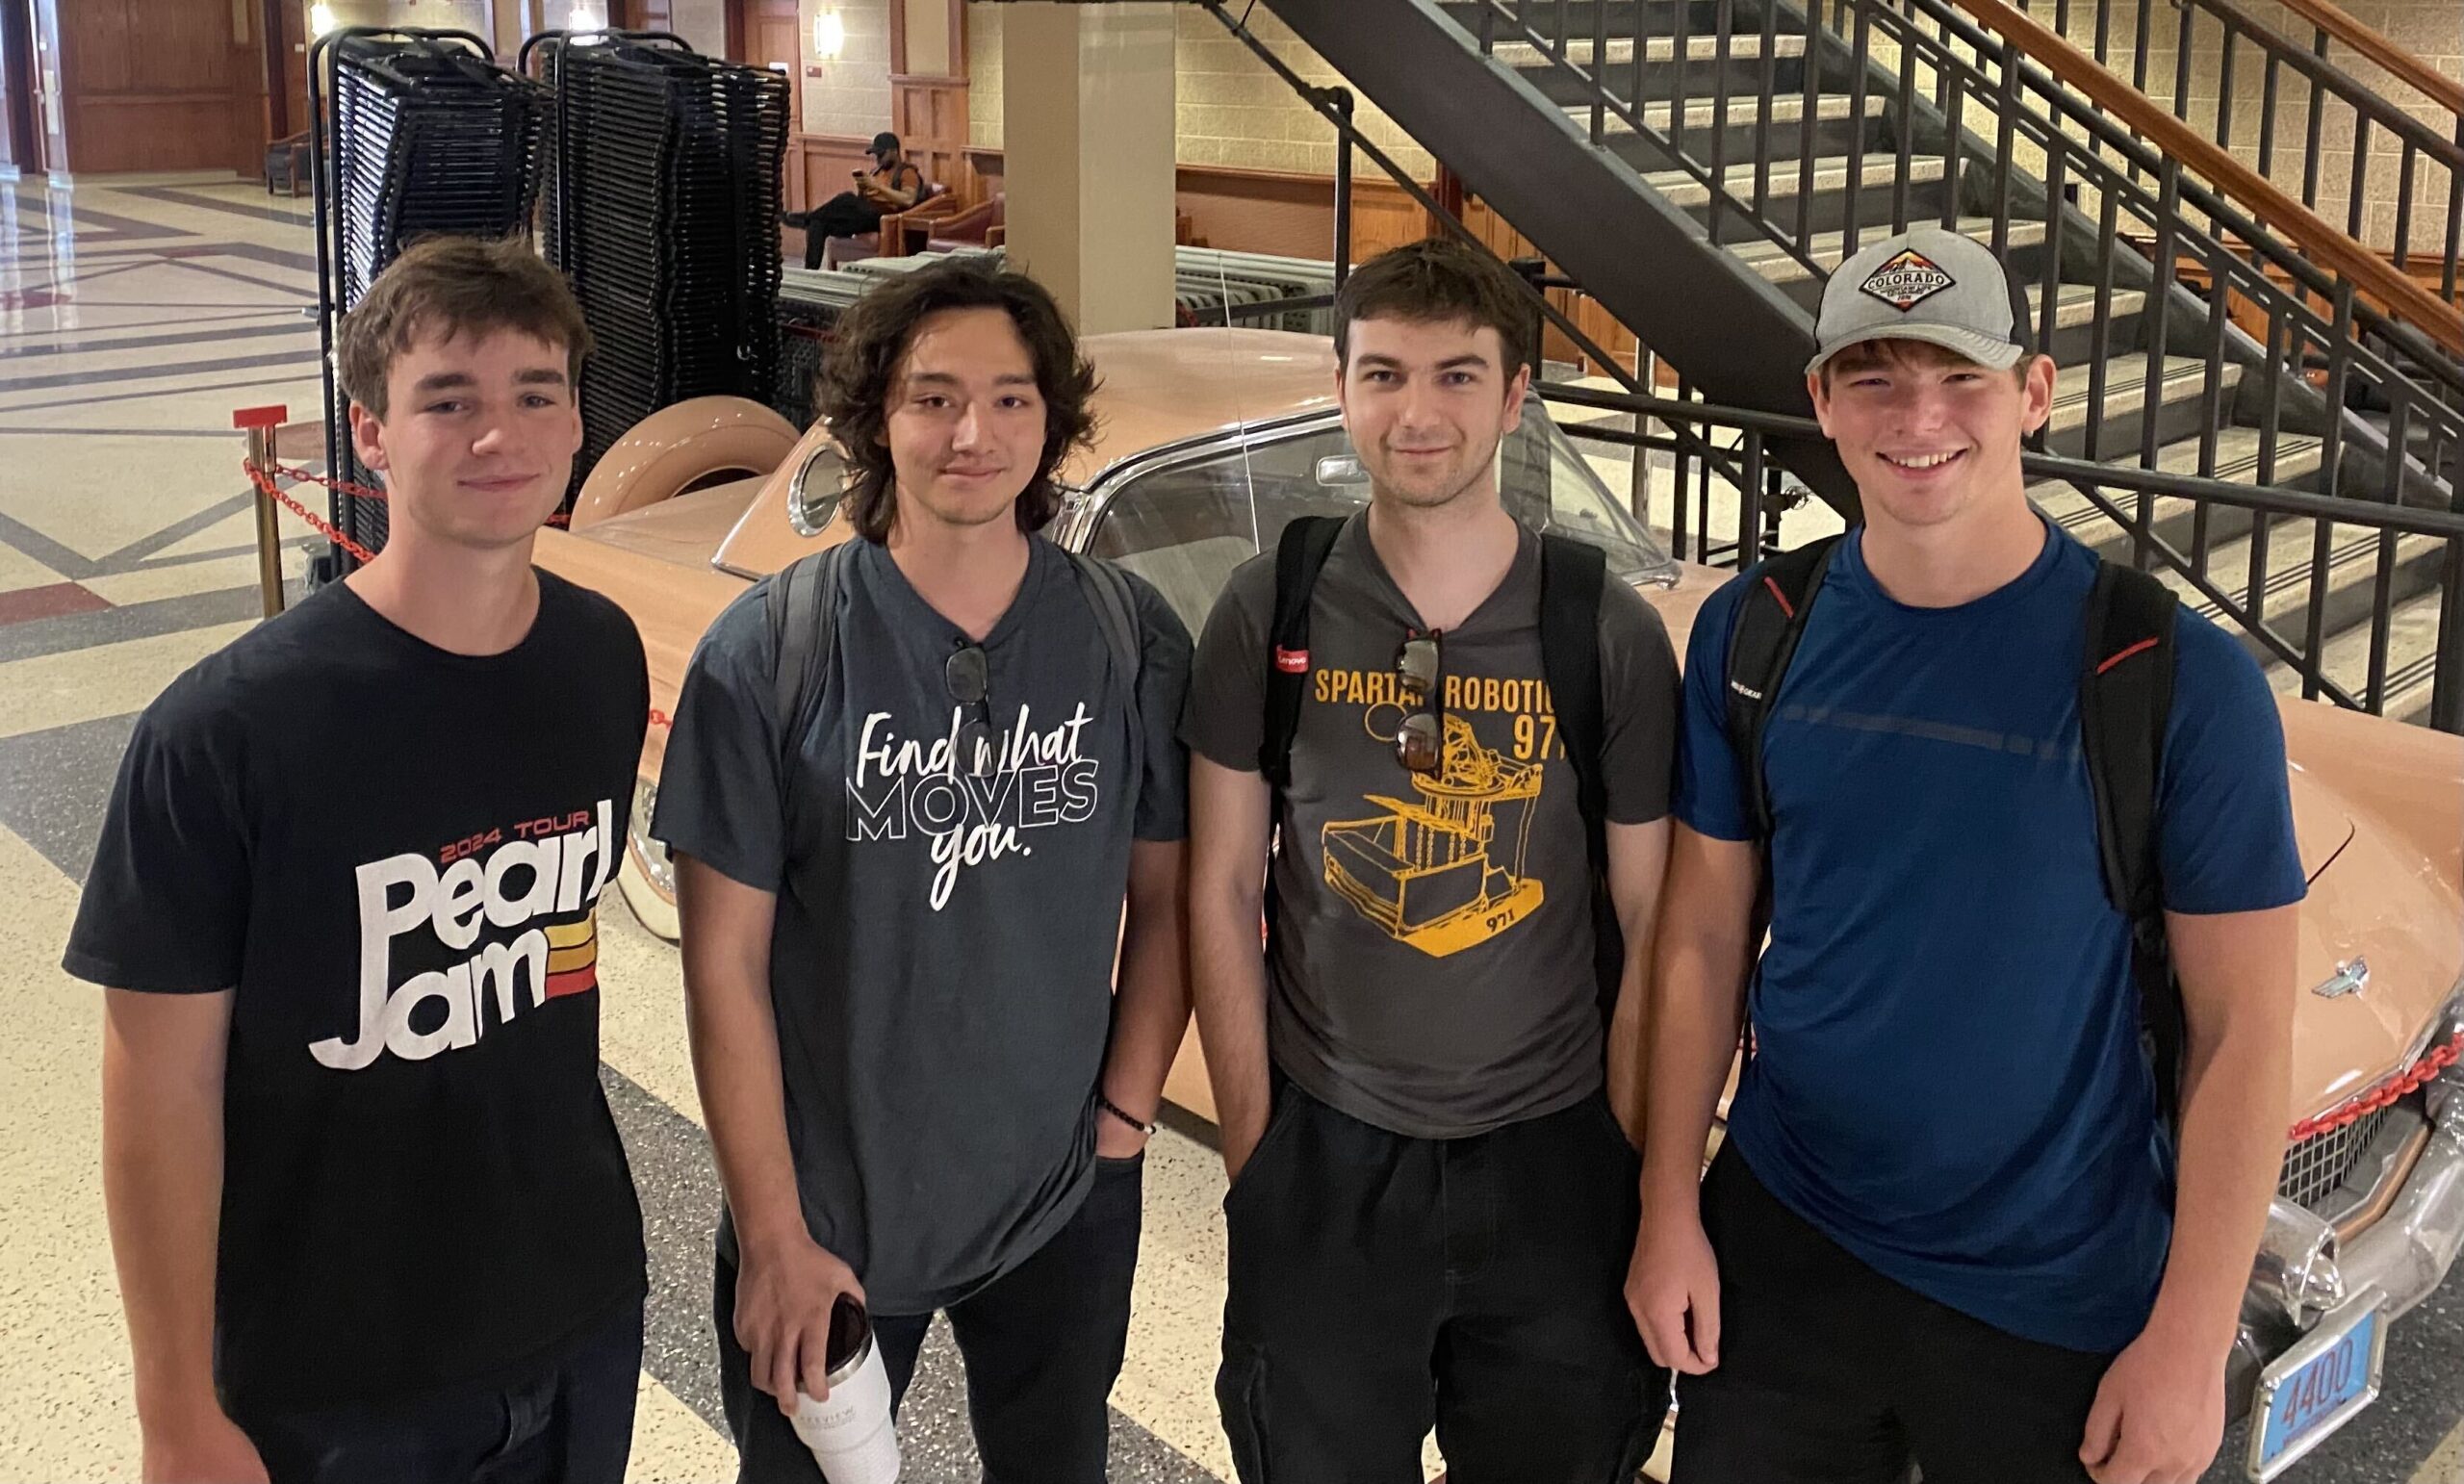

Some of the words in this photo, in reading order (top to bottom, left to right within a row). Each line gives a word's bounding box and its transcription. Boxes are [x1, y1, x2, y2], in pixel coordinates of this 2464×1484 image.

[1867, 273, 1944, 290] COLORADO
[1277, 656, 1307, 665] Lenovo
[1315, 669, 1424, 706] SPARTA
[857, 705, 962, 788] Find
[973, 702, 1094, 777] what
[845, 758, 1099, 841] MOVES
[440, 828, 502, 864] 2024
[514, 810, 590, 839] TOUR
[930, 823, 1032, 911] you.
[355, 799, 613, 951] Pearl
[1486, 908, 1515, 933] 971
[308, 928, 550, 1071] Jam
